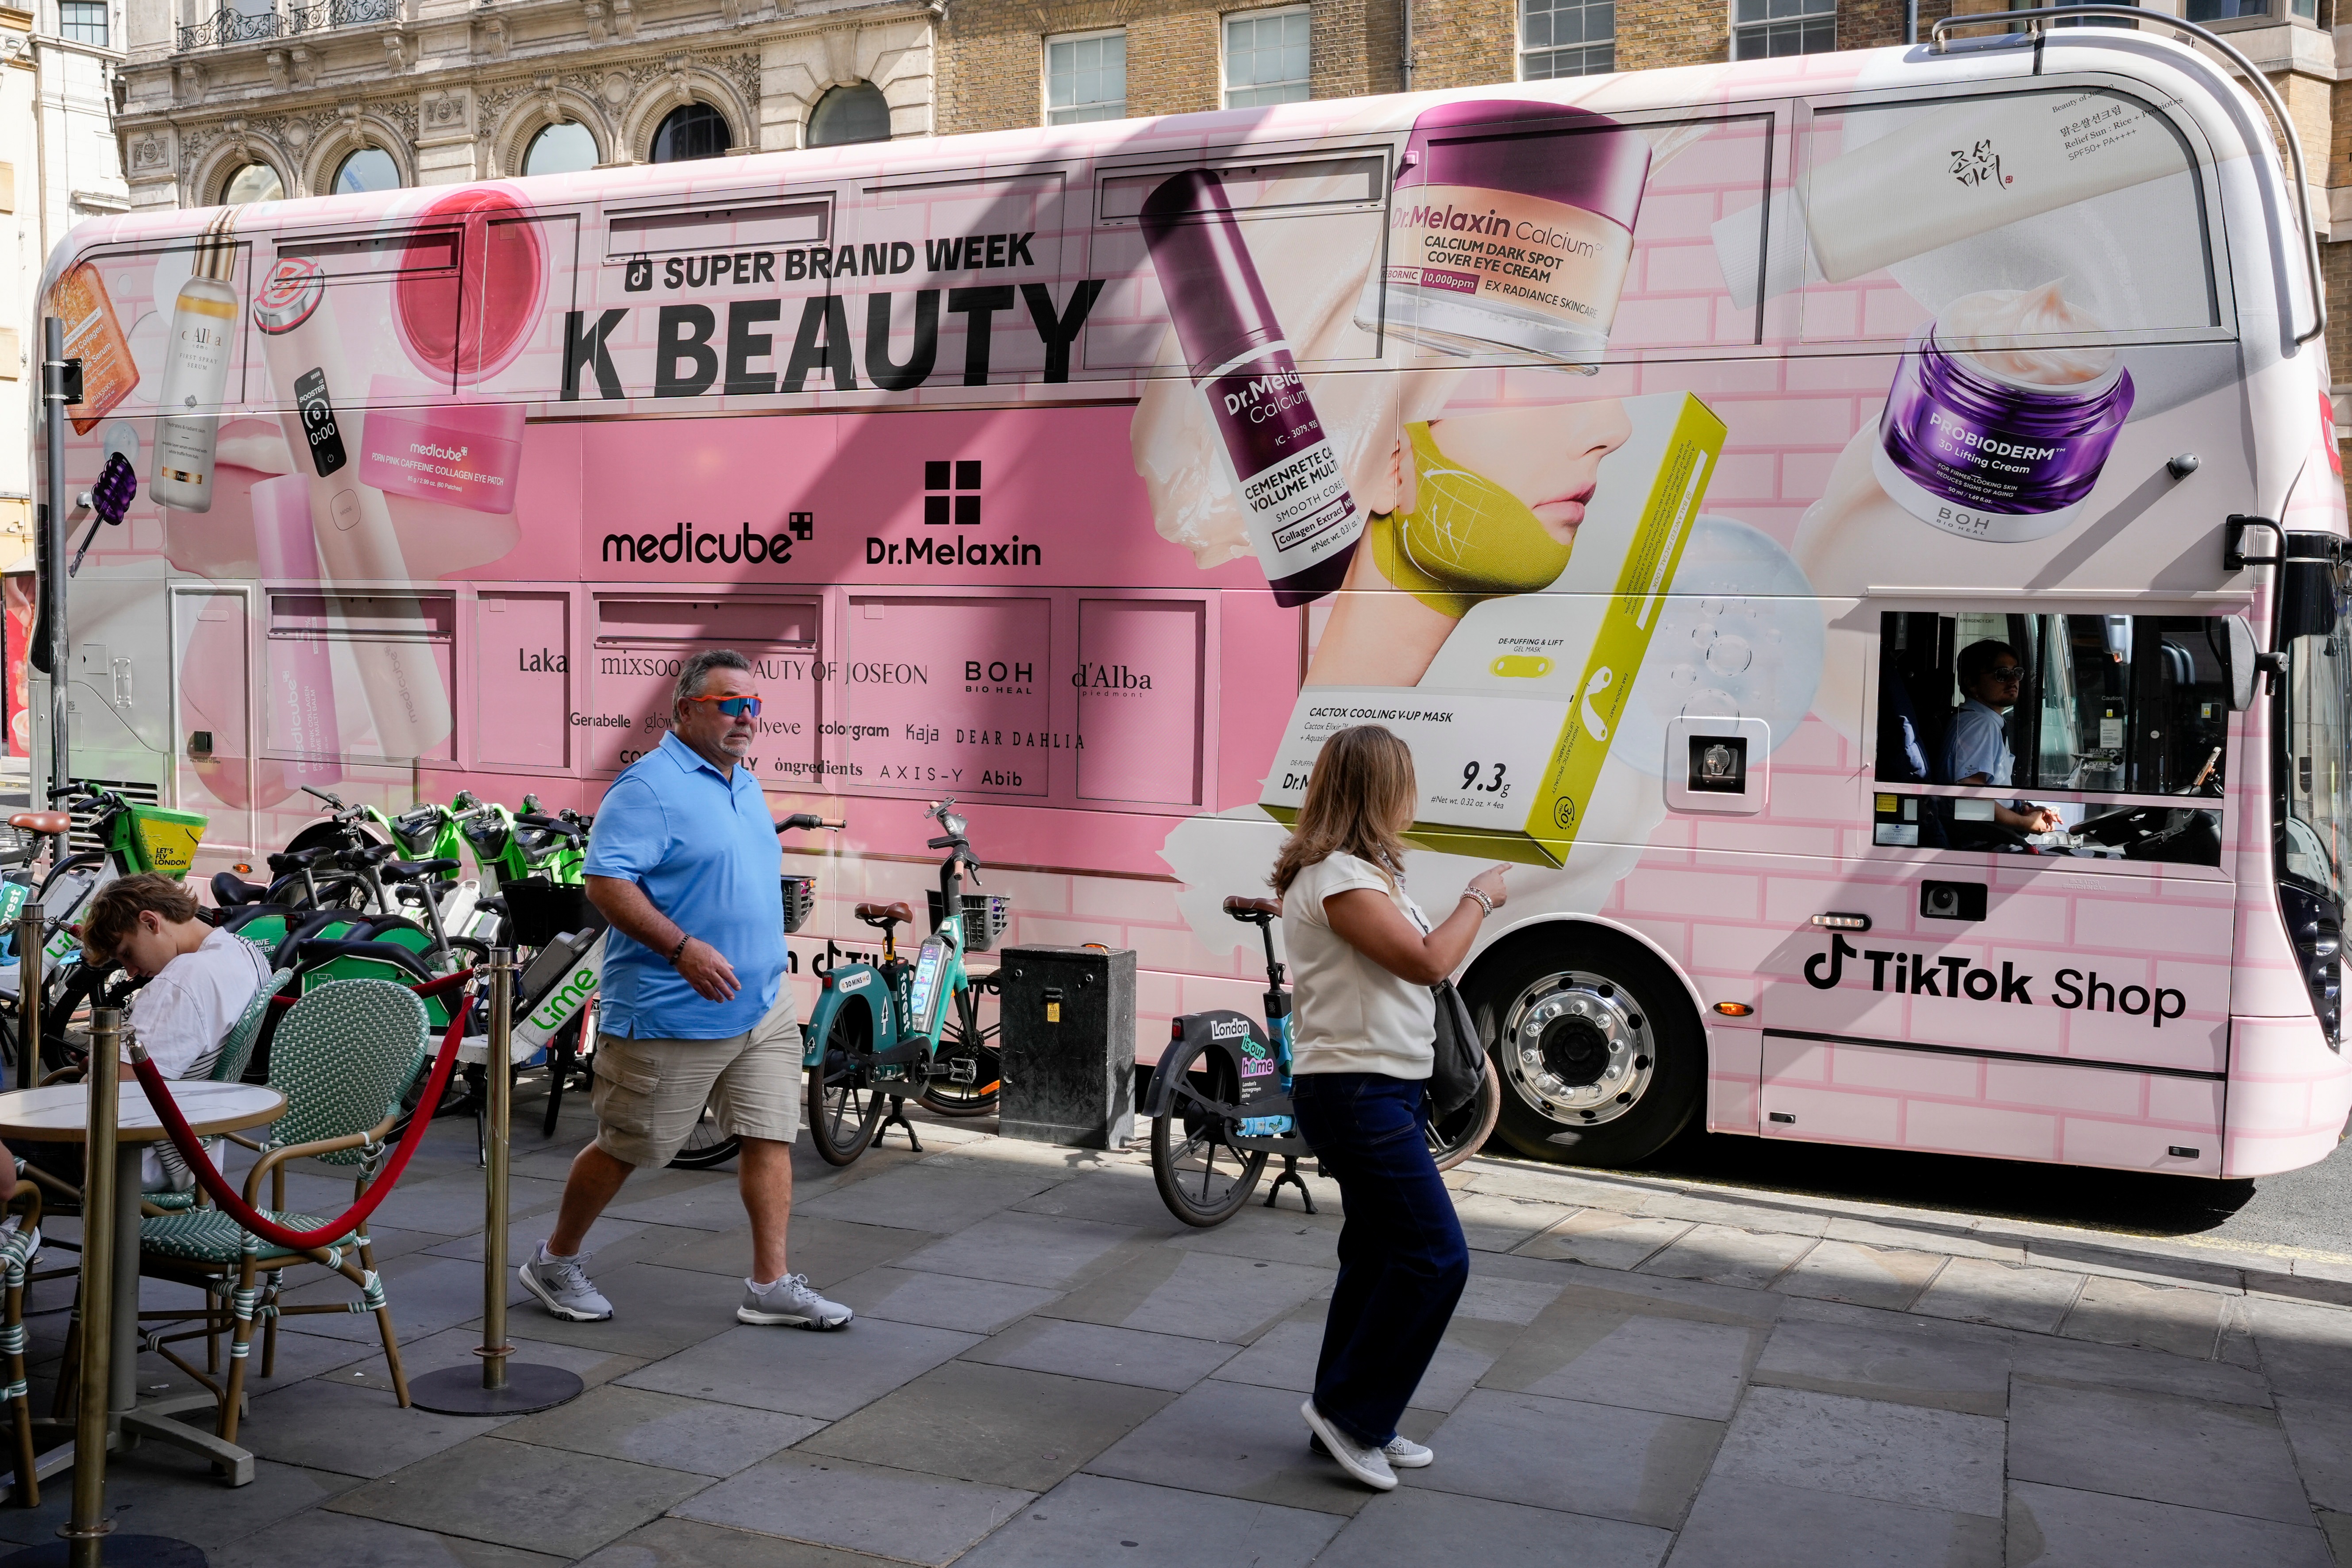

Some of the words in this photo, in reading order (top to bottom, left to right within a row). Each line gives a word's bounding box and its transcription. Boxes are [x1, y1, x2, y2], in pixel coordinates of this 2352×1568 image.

[2052, 98, 2077, 114] Beauty
[2079, 93, 2087, 103] of
[2088, 82, 2114, 99] Joseon
[2064, 133, 2089, 150] Relief
[2091, 127, 2106, 140] Sun
[2113, 116, 2132, 130] Rice
[2142, 98, 2183, 118] Probiotics
[2068, 142, 2101, 161] SPF50+
[2103, 128, 2137, 147] PA++++
[1391, 204, 1511, 238] Dr.Melaxin
[1515, 221, 1594, 258] Calcium
[663, 252, 774, 289] SUPER
[785, 242, 913, 281] BRAND
[925, 232, 1035, 272] WEEK
[1424, 235, 1484, 254] CALCIUM
[1486, 243, 1525, 262] DARK
[1528, 252, 1563, 270] SPOT
[1427, 250, 1471, 267] COVER
[1474, 258, 1499, 272] EYE
[1502, 263, 1551, 283] CREAM
[1424, 273, 1474, 289] 10,000ppm
[1485, 279, 1501, 292] EX
[1503, 283, 1559, 306] RADIANCE
[1560, 297, 1598, 319] SKINCARE
[78, 324, 104, 349] Collagen
[560, 308, 630, 401] K
[654, 280, 1106, 399] BEAUTY
[92, 342, 112, 363] Serum
[91, 379, 115, 403] mixsoon
[299, 384, 325, 403] BOOSTER
[312, 408, 321, 420] 6
[1250, 389, 1310, 424] Calcium
[311, 423, 335, 445] 0:00
[410, 443, 462, 462] medicube
[1938, 439, 1952, 451] 3D
[1955, 448, 1987, 468] Lifting
[1992, 460, 2030, 474] Cream
[372, 452, 385, 462] PDRN
[386, 455, 400, 466] PINK
[401, 458, 434, 473] CAFFEINE
[435, 466, 473, 481] COLLAGEN
[474, 473, 486, 483] EYE
[487, 476, 504, 486] PATCH
[1245, 451, 1323, 500] CEMENRETE
[1936, 470, 1962, 484] REDUCES
[1963, 480, 1982, 492] SIGNS
[1993, 489, 2013, 498] AGING
[1937, 462, 1949, 472] FOR
[1950, 466, 2002, 490] FIRMER-LOOKING
[2003, 482, 2018, 491] SKIN
[444, 483, 462, 493] Patches)
[1250, 478, 1309, 513] VOLUME
[1276, 494, 1321, 522] SMOOTH
[1323, 480, 1342, 497] CORE
[1967, 492, 1979, 501] 1.69
[340, 506, 352, 516] MODE
[1278, 523, 1315, 545] Collagen
[1316, 505, 1343, 526] Extract
[1671, 501, 1688, 541] BALANCED
[1938, 507, 1990, 530] BOH
[1936, 519, 1953, 528] BIO
[1958, 526, 1985, 536] HEAL
[603, 522, 793, 564] medicube
[866, 535, 1040, 565] Dr.Melaxin
[1310, 536, 1329, 553] #Net
[1660, 542, 1672, 567] FACIAL
[1653, 567, 1663, 589] LOOK
[520, 648, 569, 673] Laka
[601, 650, 681, 677] mixsoo
[811, 661, 838, 681] OF
[845, 663, 927, 685] JOSEON
[966, 661, 1032, 682] BOH
[1072, 663, 1152, 690] d'Alba
[391, 651, 417, 724] medicube
[1615, 685, 1624, 703] HOOK
[304, 686, 313, 727] COLLAGEN
[1309, 708, 1348, 717] CACTOX
[1350, 709, 1397, 720] COOLING
[1398, 710, 1420, 721] V-UP
[1424, 712, 1453, 723] MASK
[288, 679, 306, 774] medicube
[570, 712, 631, 728] Genabelle
[818, 721, 889, 740] colorgram
[906, 724, 939, 744] Kaja
[957, 729, 1002, 745] DEAR
[1013, 732, 1084, 749] DAHLIA
[1561, 721, 1574, 744] LIFTING
[310, 751, 318, 771] PDRN
[1556, 744, 1567, 765] FABRIC
[1563, 726, 1579, 766] HIGH-ELASTIC
[880, 765, 962, 782] AXIS-Y
[982, 770, 1022, 786] Abib
[1552, 765, 1564, 795] SPECIALTY
[1431, 796, 1447, 805] #Net
[1561, 804, 1571, 824] 30
[852, 977, 862, 986] MINS
[1864, 950, 2033, 1006] TikTok
[2052, 968, 2186, 1028] Shop
[529, 969, 598, 1030] Lime
[901, 972, 910, 1032] forest
[1214, 1022, 1248, 1036] London
[1243, 1035, 1250, 1049] is
